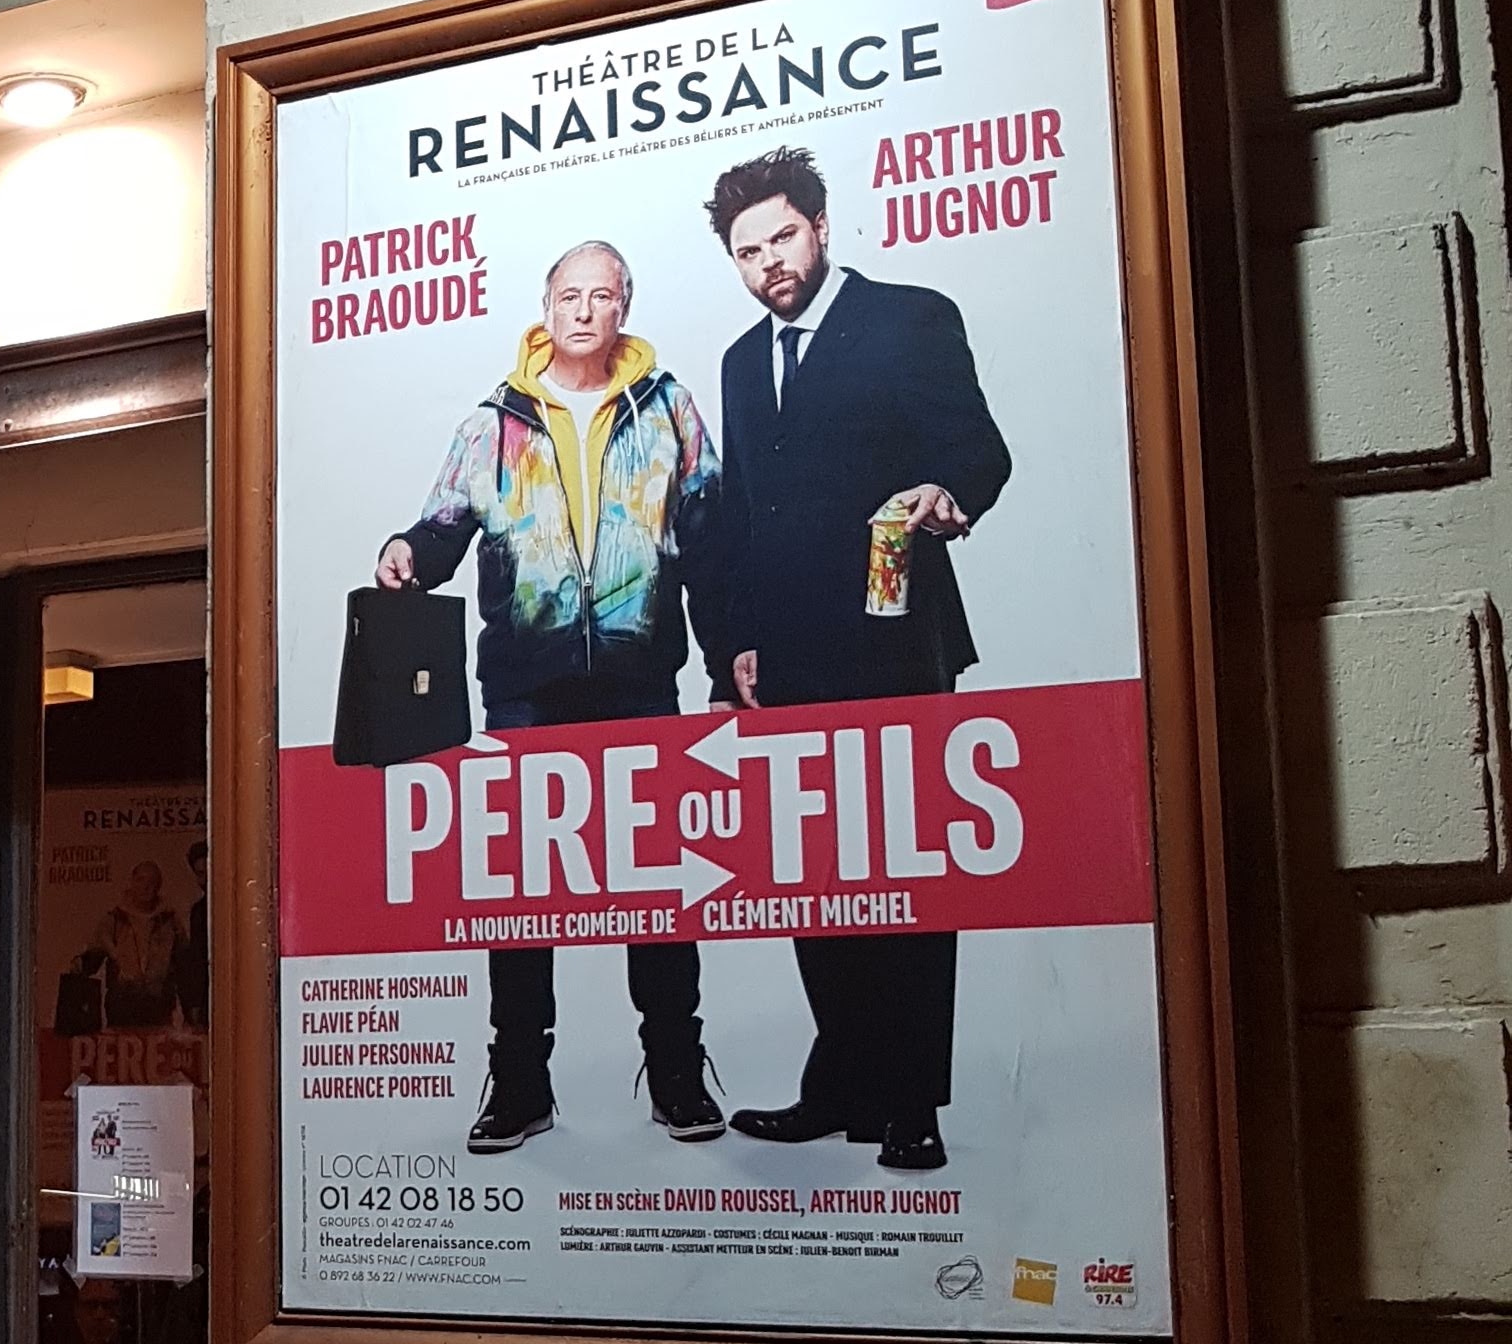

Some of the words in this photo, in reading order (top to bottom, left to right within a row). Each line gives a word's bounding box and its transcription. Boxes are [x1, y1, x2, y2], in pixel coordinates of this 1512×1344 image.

[532, 43, 684, 96] THÉÂTRE
[696, 31, 740, 64] DE
[752, 22, 795, 51] LA
[408, 22, 943, 178] RENAISSANCE
[458, 179, 471, 188] LA
[473, 166, 531, 185] FRANÇAISE
[534, 163, 547, 173] DE
[602, 149, 616, 160] LE
[618, 139, 667, 157] THÉÂTRE
[670, 135, 691, 148] DES
[693, 126, 738, 143] BÉLIERS
[741, 123, 755, 134] ET
[758, 112, 805, 131] ANTHÉA
[808, 98, 885, 122] PRÉSENTENT
[873, 107, 1065, 189] ARTHUR
[881, 170, 1058, 249] JUGNOT
[320, 214, 477, 287] PATRICK
[311, 258, 489, 344] BRAOUDÉ
[83, 808, 207, 830] RENAISSA
[385, 729, 659, 905] PÈRE
[678, 788, 742, 841] OU
[766, 717, 1025, 885] FILS
[444, 917, 466, 943] LA
[470, 913, 561, 941] NOUVELLE
[565, 905, 648, 937] COMÉDIE
[651, 908, 677, 935] DE
[703, 891, 816, 932] CLÉMENT
[820, 891, 918, 927] MICHEL
[302, 978, 384, 1002] CATHERINE
[388, 975, 468, 1000] HOSMALIN
[302, 1011, 357, 1034] FLAVIE
[358, 1005, 400, 1033] PÉAN
[302, 1043, 354, 1067] JULIEN
[359, 1042, 456, 1066] PERSONNAZ
[303, 1076, 385, 1099] LAURENCE
[388, 1075, 455, 1098] PORTEIL
[320, 1155, 456, 1179] LOCATION
[319, 1186, 350, 1210] 01
[358, 1186, 391, 1211] 42
[400, 1186, 439, 1212] 08
[447, 1187, 476, 1212] 18
[483, 1187, 524, 1212] 50
[559, 1192, 592, 1210] MISE
[595, 1192, 613, 1210] EN
[617, 1188, 661, 1211] SCÈNE
[664, 1188, 716, 1212] DAVID
[721, 1189, 805, 1217] ROUSSEL,
[810, 1189, 886, 1214] ARTHUR
[890, 1190, 962, 1214] JUGNOT
[319, 1216, 370, 1227] GROUPES
[376, 1217, 388, 1228] 01
[391, 1217, 405, 1228] 42
[407, 1217, 422, 1228] 02
[319, 1231, 531, 1251] theatredelarenaissance.com
[600, 1242, 632, 1252] ARTHUR
[671, 1244, 714, 1253] ASSISTANT
[716, 1244, 754, 1254] METTEUR
[756, 1245, 767, 1255] EN
[768, 1243, 793, 1255] SCÈNE
[661, 1228, 706, 1238] AZZOPARDI
[713, 1229, 756, 1239] COSTUMES
[791, 1230, 828, 1240] MAGNAN
[835, 1231, 874, 1243] MUSIQUE
[881, 1232, 916, 1242] ROMAIN
[918, 1232, 964, 1243] TROUILLET
[319, 1254, 375, 1265] MAGASINS
[377, 1254, 408, 1266] FNAC
[418, 1255, 486, 1268] CARREFOUR
[1015, 1266, 1059, 1281] fnac
[406, 1272, 501, 1285] WWW.FNAC.COM
[1096, 1294, 1123, 1305] 97.4
